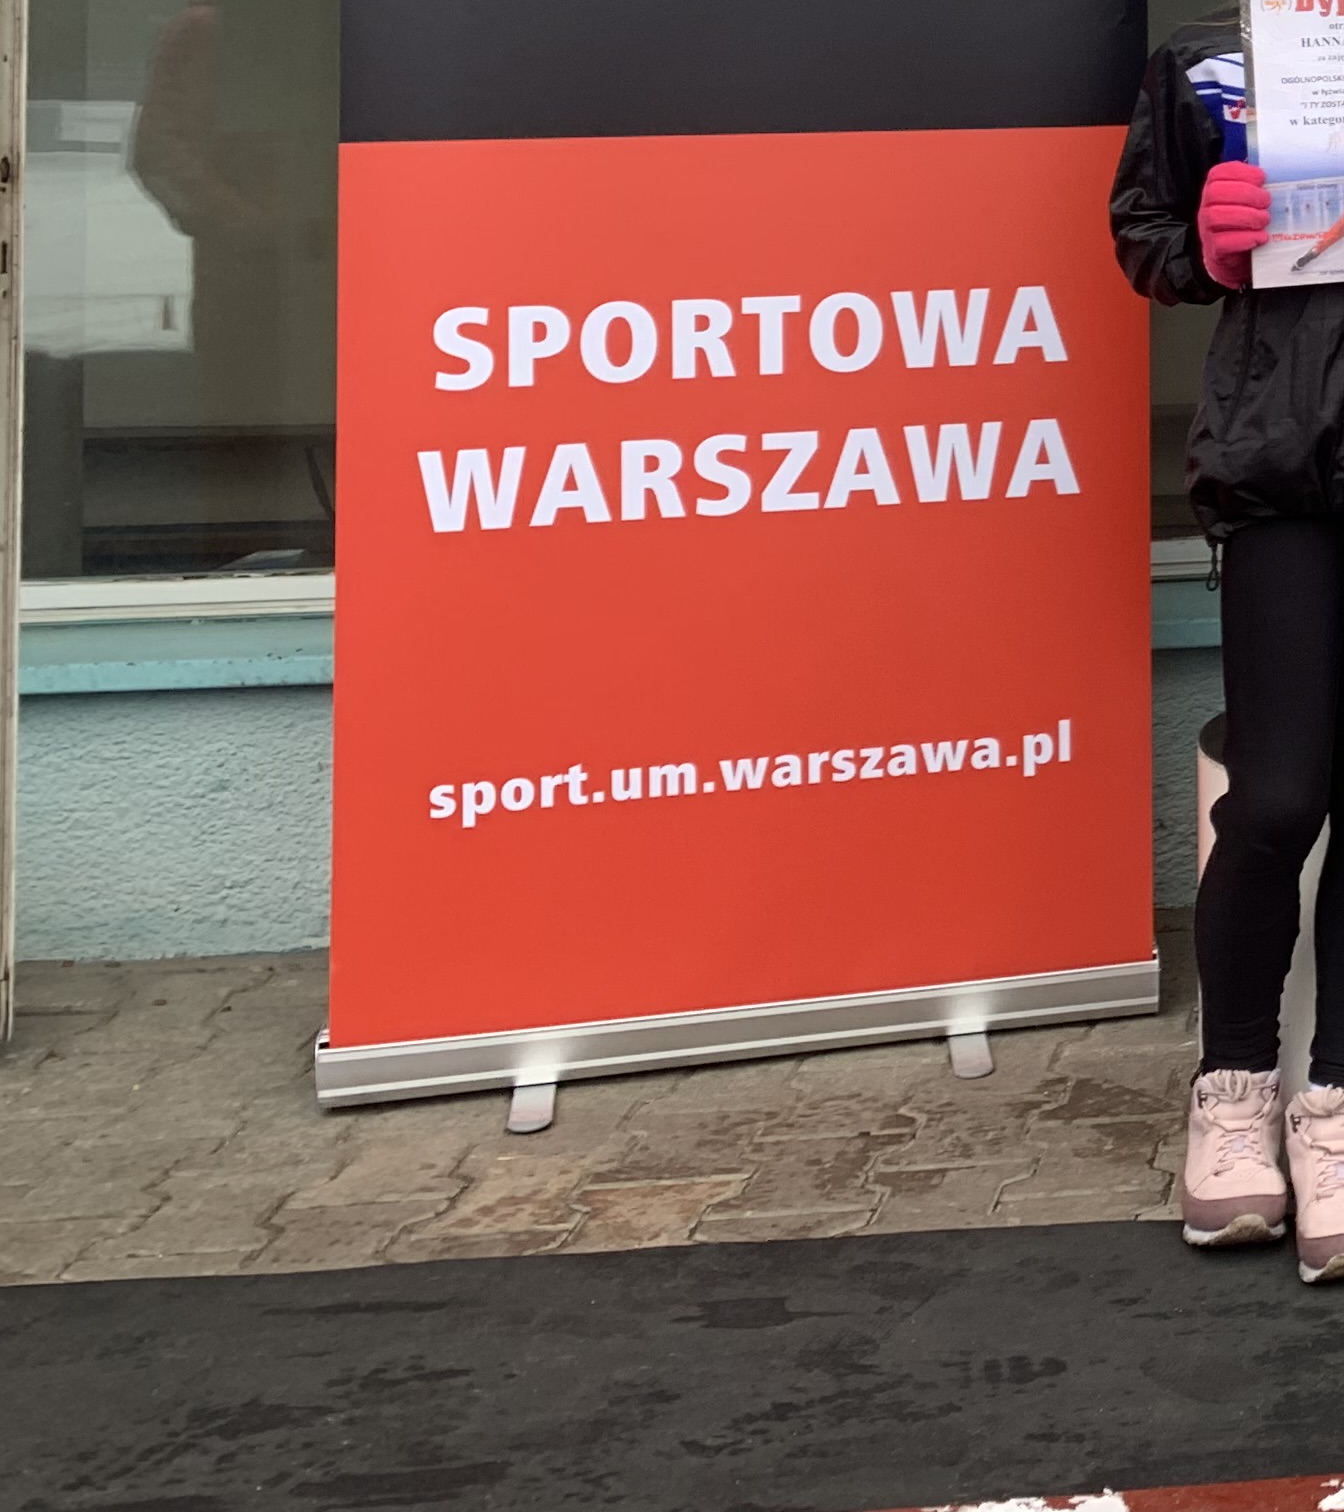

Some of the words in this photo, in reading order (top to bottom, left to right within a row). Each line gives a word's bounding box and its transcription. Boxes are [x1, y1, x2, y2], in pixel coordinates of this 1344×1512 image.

[431, 285, 1069, 392] SPORTOWA
[416, 418, 1081, 534] WARSZAWA
[428, 719, 1073, 829] sport.um.warszawa.pl
